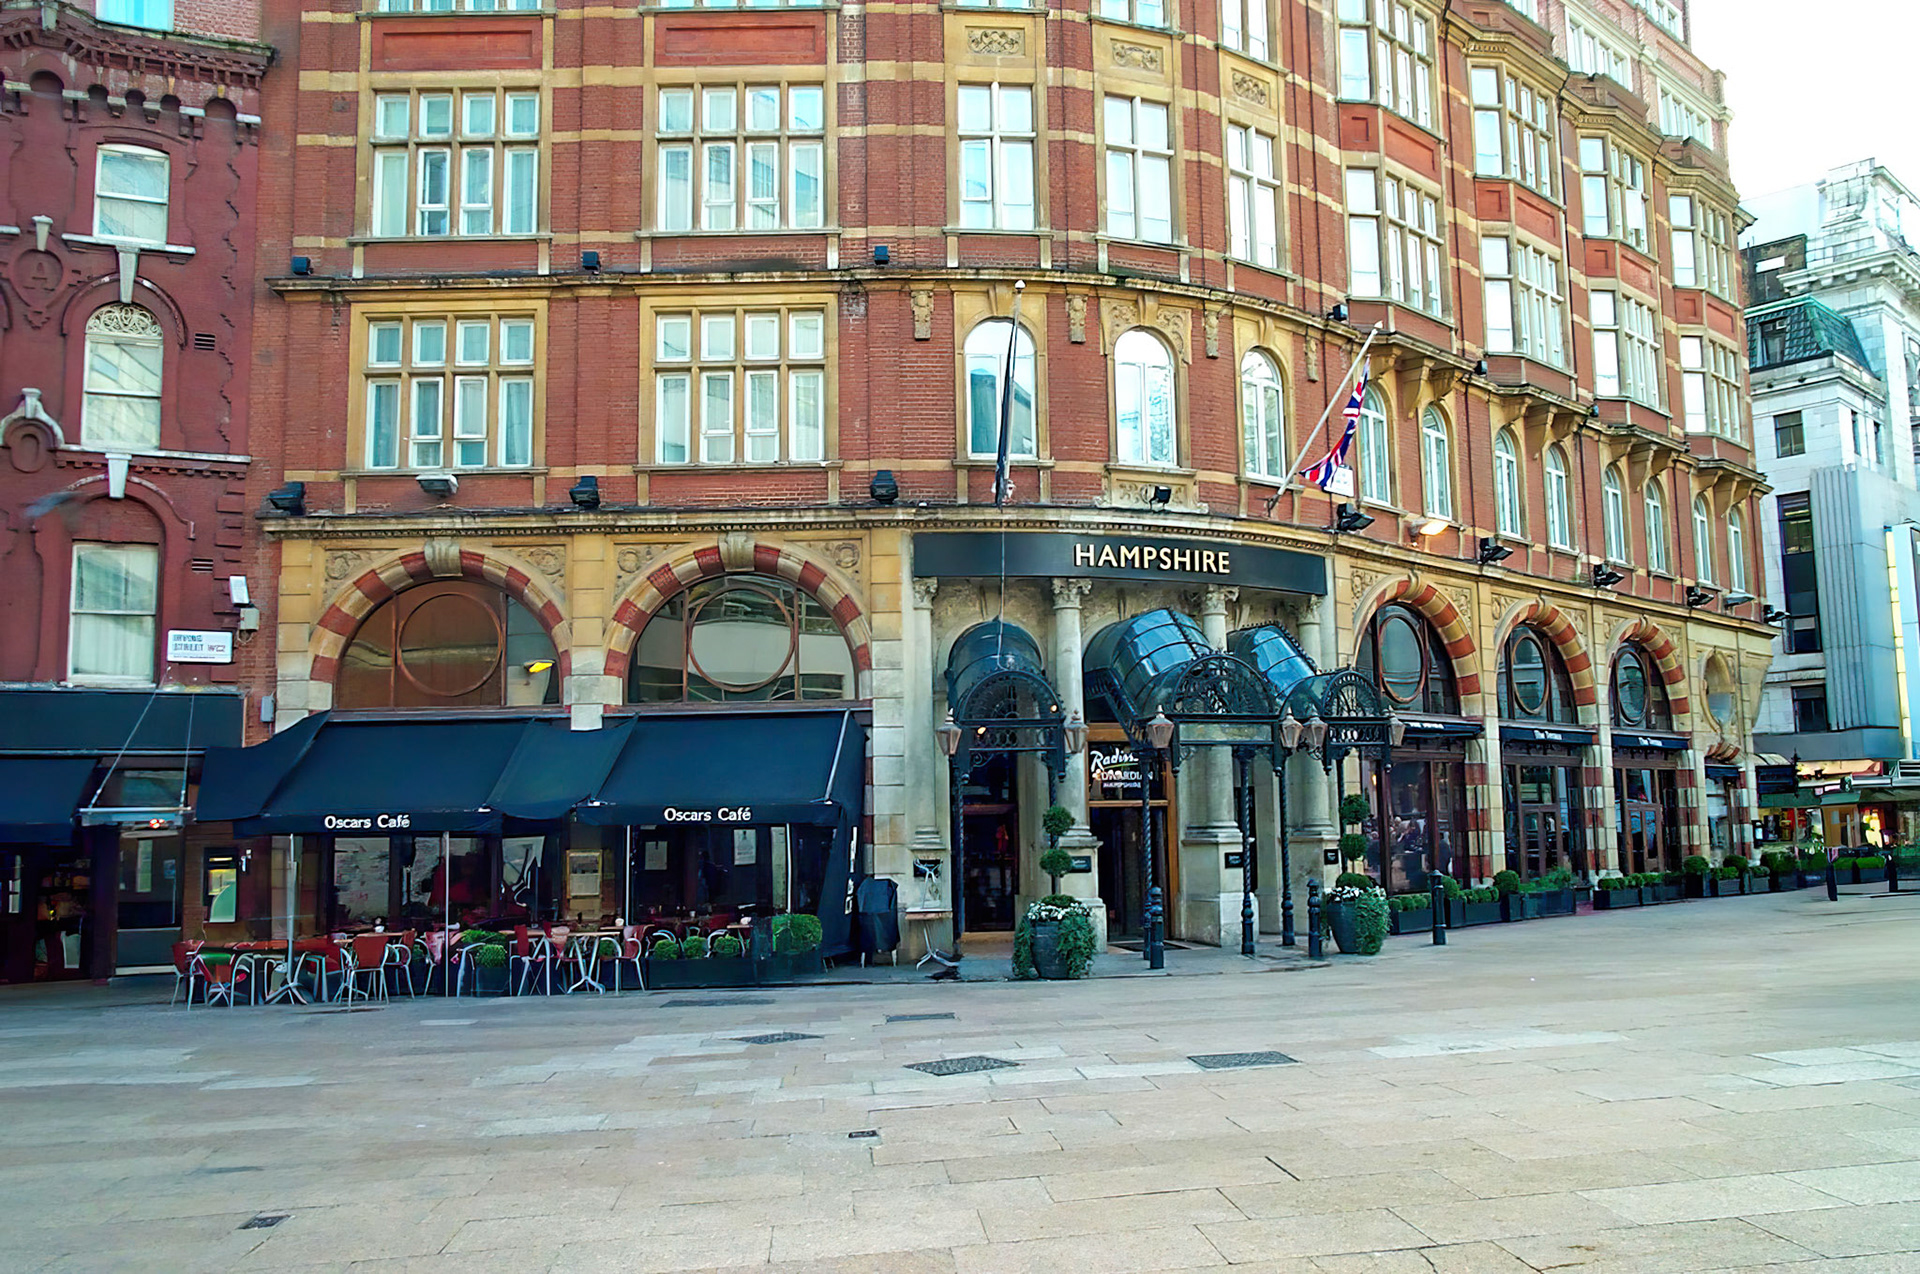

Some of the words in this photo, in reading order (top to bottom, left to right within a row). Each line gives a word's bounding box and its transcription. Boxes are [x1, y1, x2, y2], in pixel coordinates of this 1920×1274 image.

[1075, 543, 1231, 574] HAMPSHIRE
[324, 815, 372, 829] Oscars
[377, 814, 410, 828] Café
[664, 808, 712, 821] Oscars
[718, 807, 752, 821] Café
